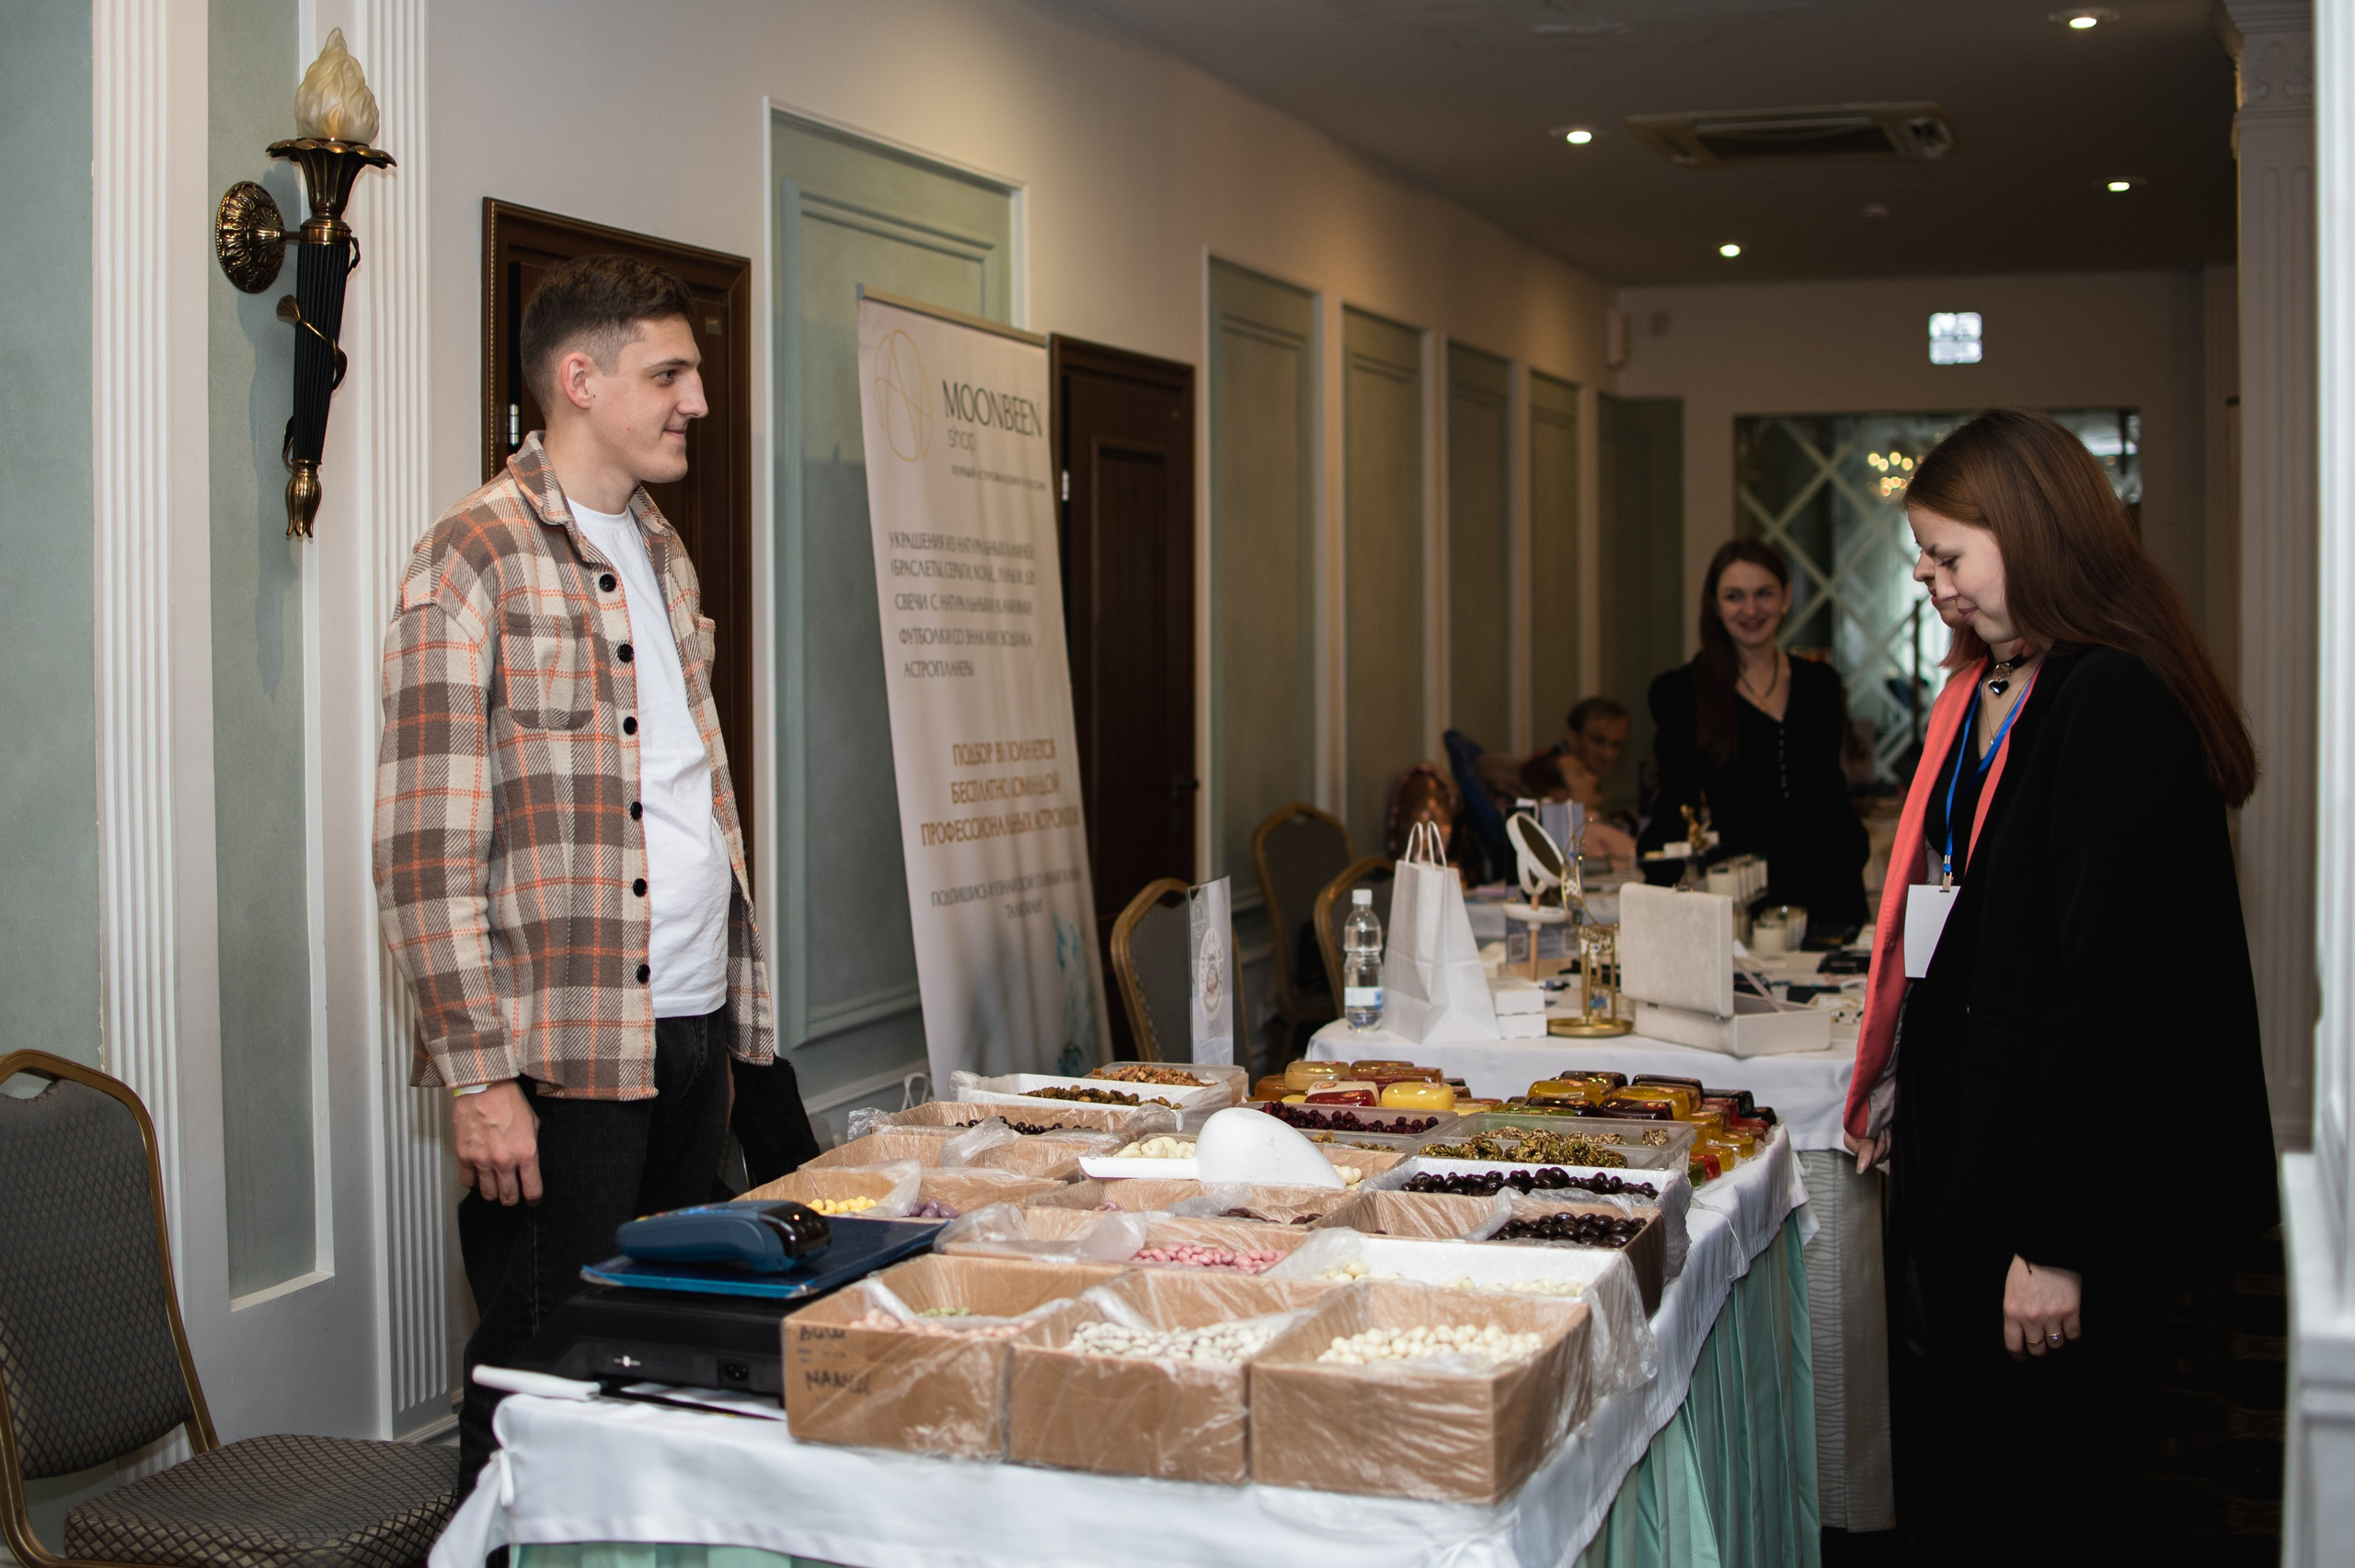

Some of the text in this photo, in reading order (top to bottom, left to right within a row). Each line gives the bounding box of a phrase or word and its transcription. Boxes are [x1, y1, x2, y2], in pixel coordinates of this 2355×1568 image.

[942, 379, 1042, 438] MOONBEEN
[888, 531, 944, 551] УКРАШЕНИЯ
[894, 593, 928, 611] СВЕЧИ
[930, 593, 939, 611] С
[899, 628, 951, 646] ФУТБОЛКИ
[952, 742, 992, 766] ПОДБОР
